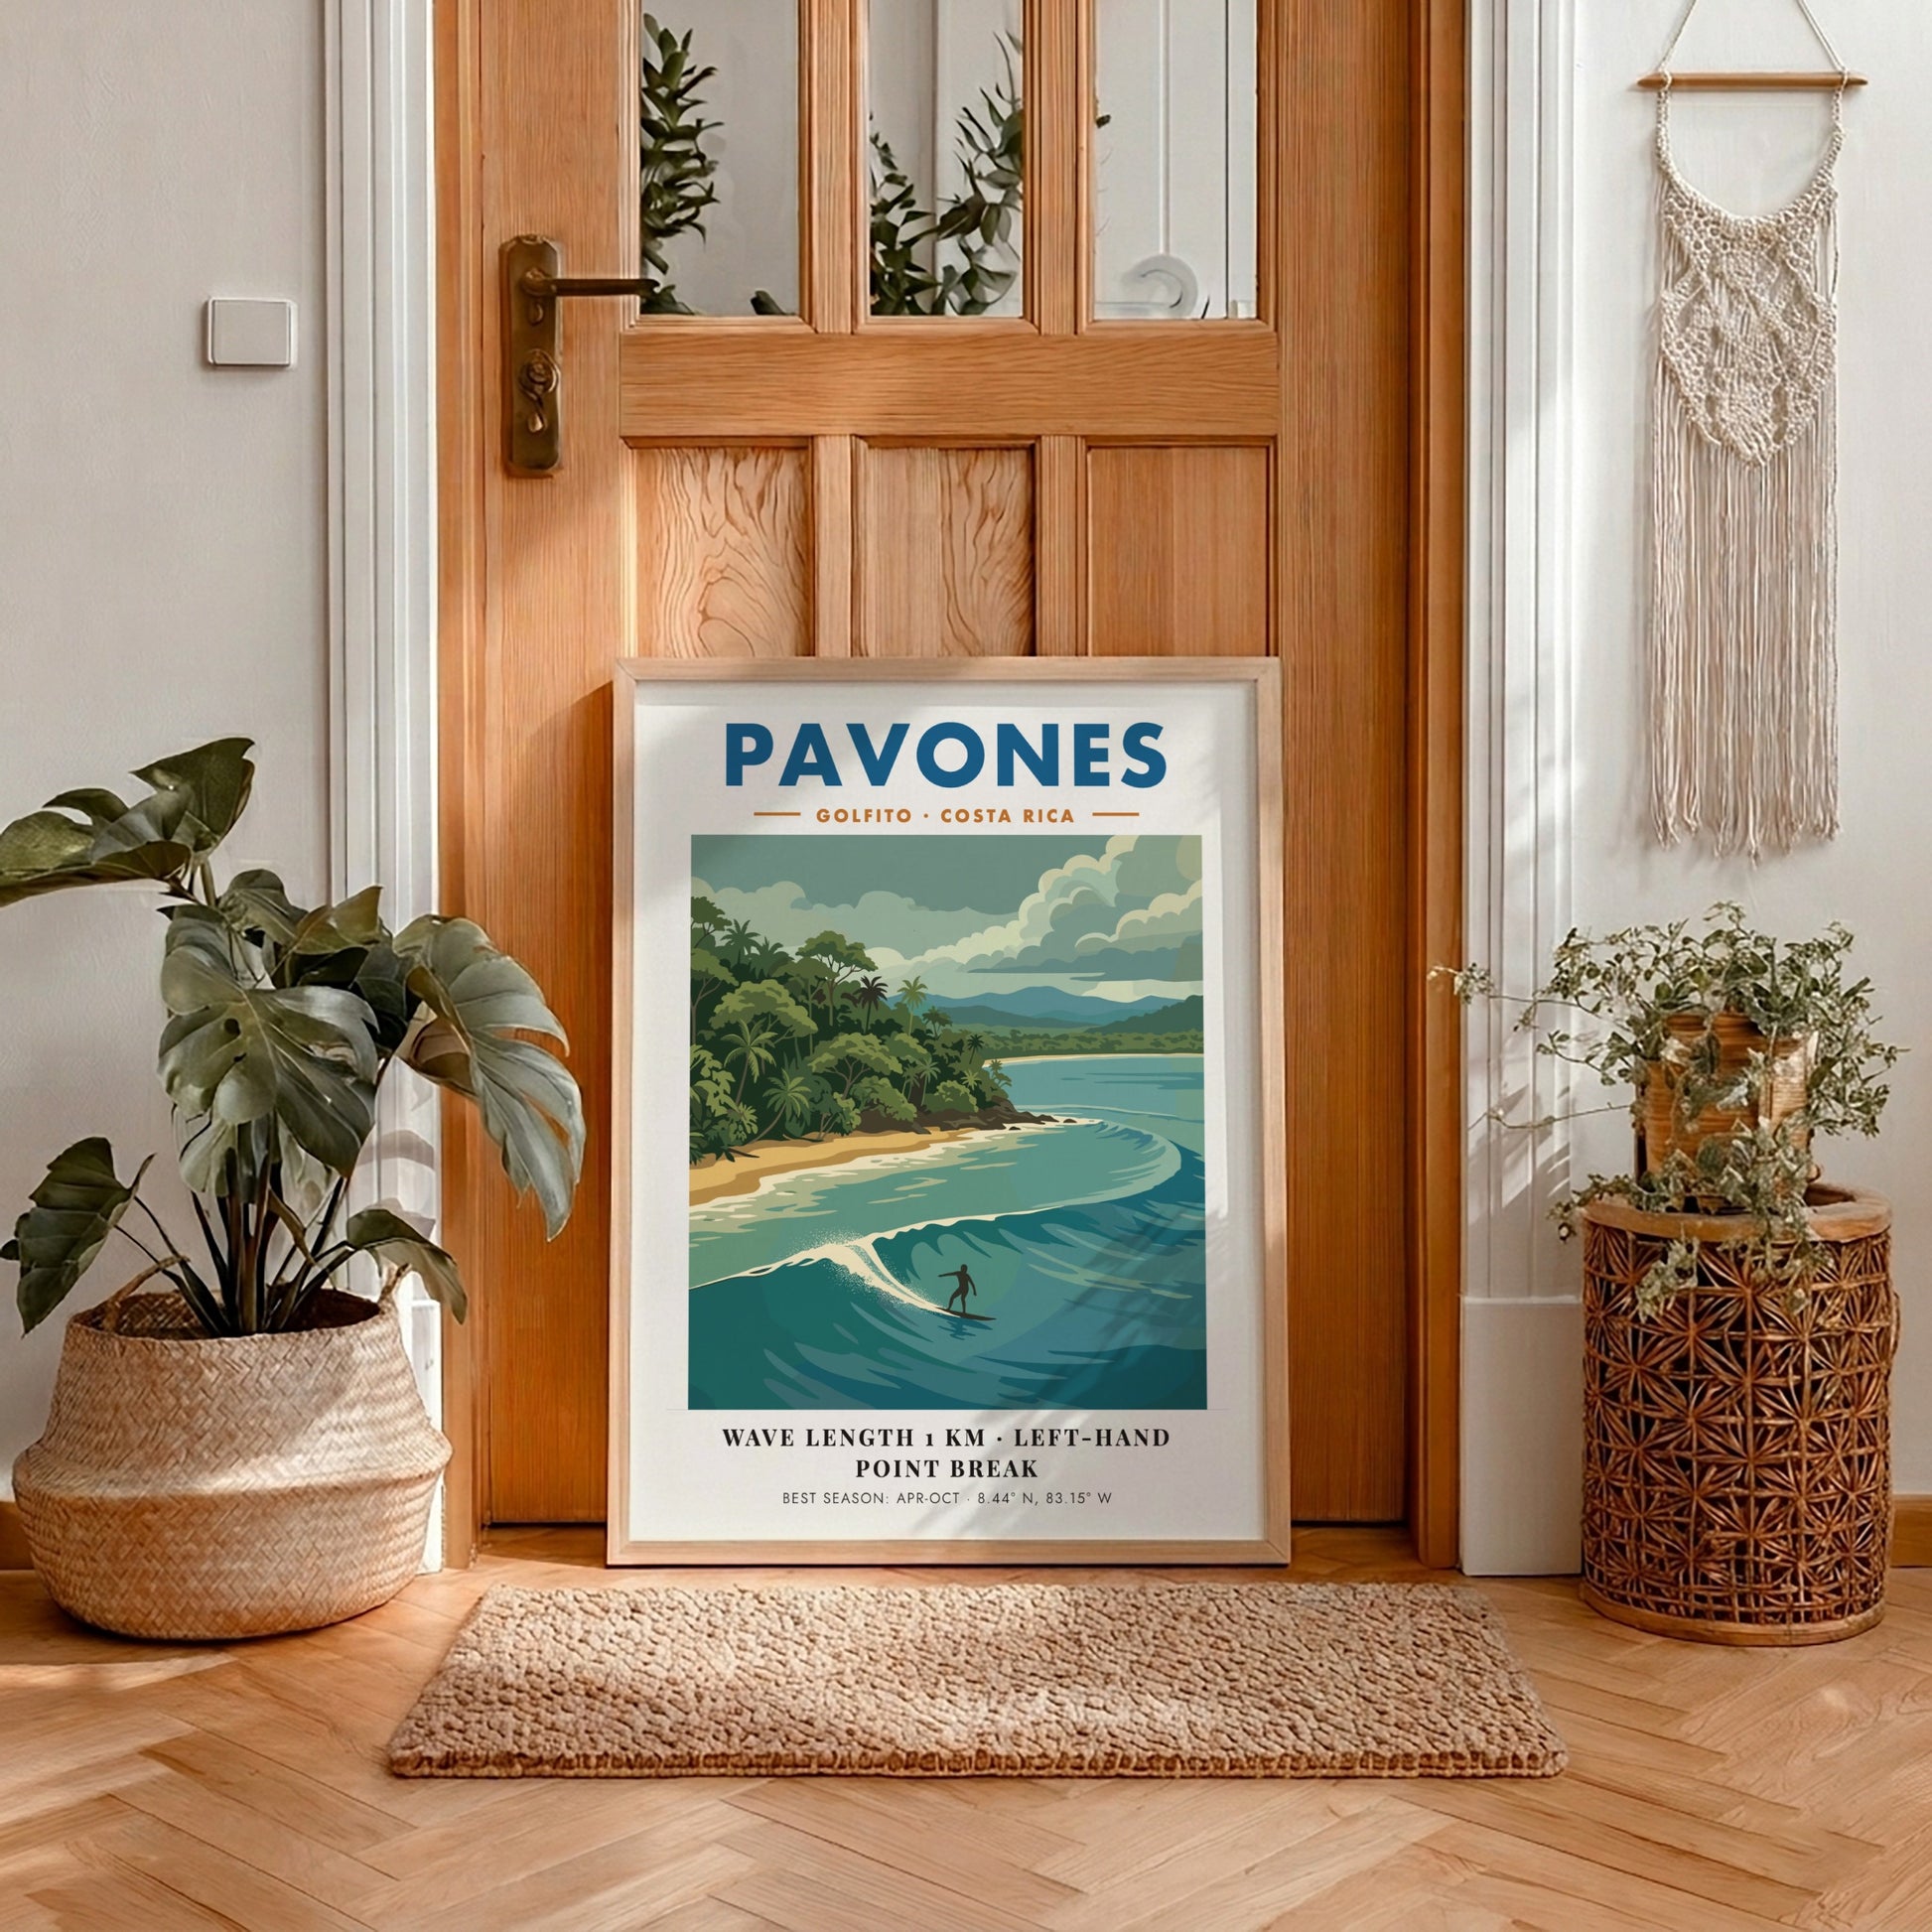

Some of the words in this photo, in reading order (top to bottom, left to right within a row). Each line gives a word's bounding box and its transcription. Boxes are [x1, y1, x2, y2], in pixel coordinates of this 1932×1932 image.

[725, 721, 1168, 789] PAVONES
[816, 807, 912, 824] GOLFITO
[940, 807, 1013, 824] COSTA
[1023, 807, 1075, 824] RICA
[722, 1428, 794, 1448] WAVE
[805, 1428, 914, 1448] LENGTH
[925, 1432, 934, 1448] 1
[945, 1428, 986, 1448] KM
[1014, 1428, 1170, 1448] LEFT-HAND
[855, 1458, 940, 1479] POINT
[950, 1459, 1038, 1479] BREAK
[782, 1491, 816, 1504] BEST
[823, 1491, 890, 1504] SEASON:
[896, 1491, 959, 1504] APR-OCT
[977, 1491, 1016, 1504] 8.44°
[1022, 1491, 1038, 1506] N,
[1045, 1491, 1092, 1504] 83.15°
[1097, 1491, 1113, 1504] W
